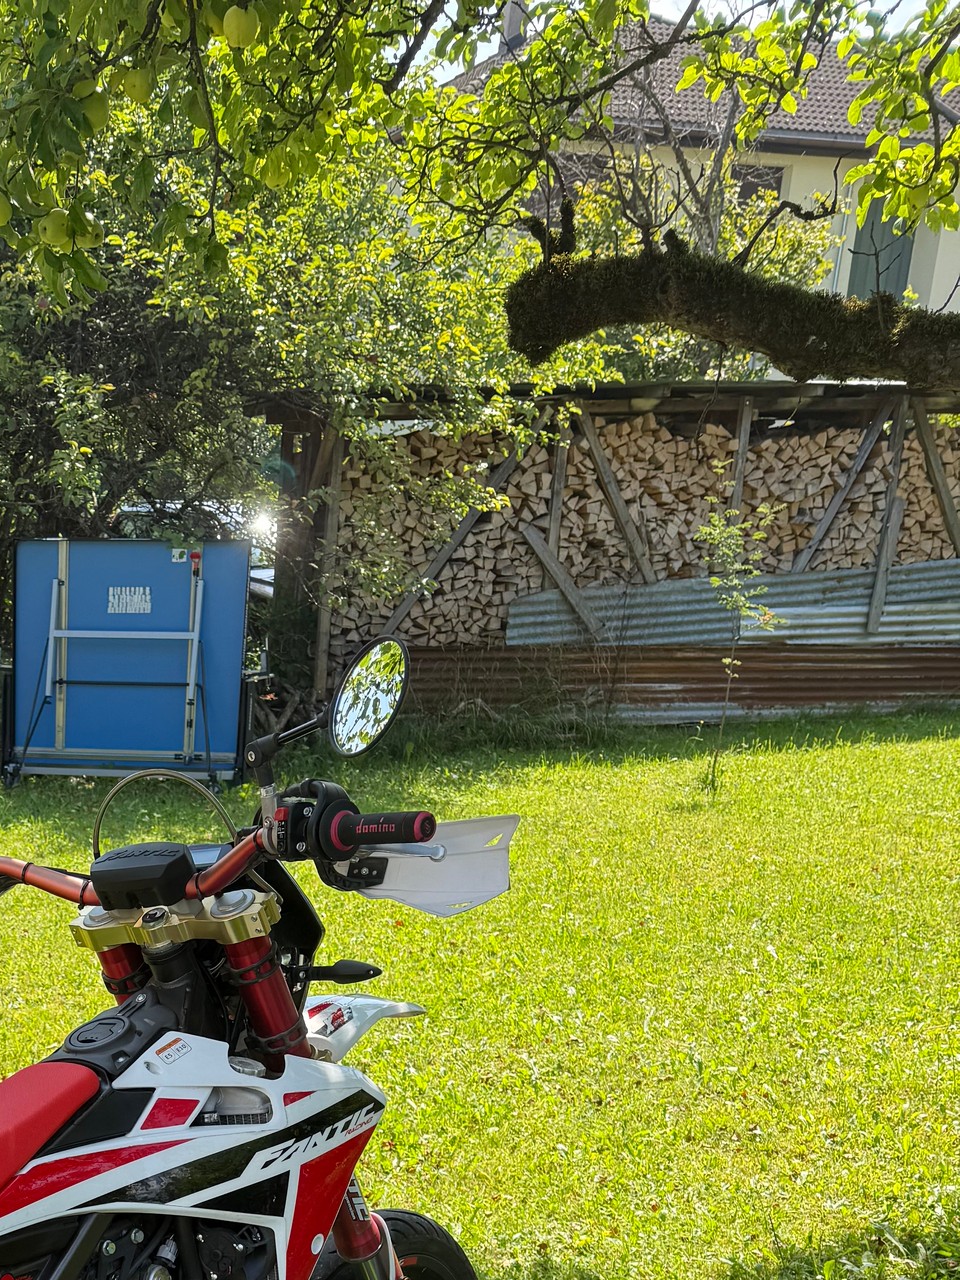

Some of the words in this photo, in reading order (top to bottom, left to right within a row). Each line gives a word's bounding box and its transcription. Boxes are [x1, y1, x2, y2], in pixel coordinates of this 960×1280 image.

[355, 816, 396, 835] domino
[164, 1052, 173, 1060] E5
[242, 1102, 375, 1175] FANTIC
